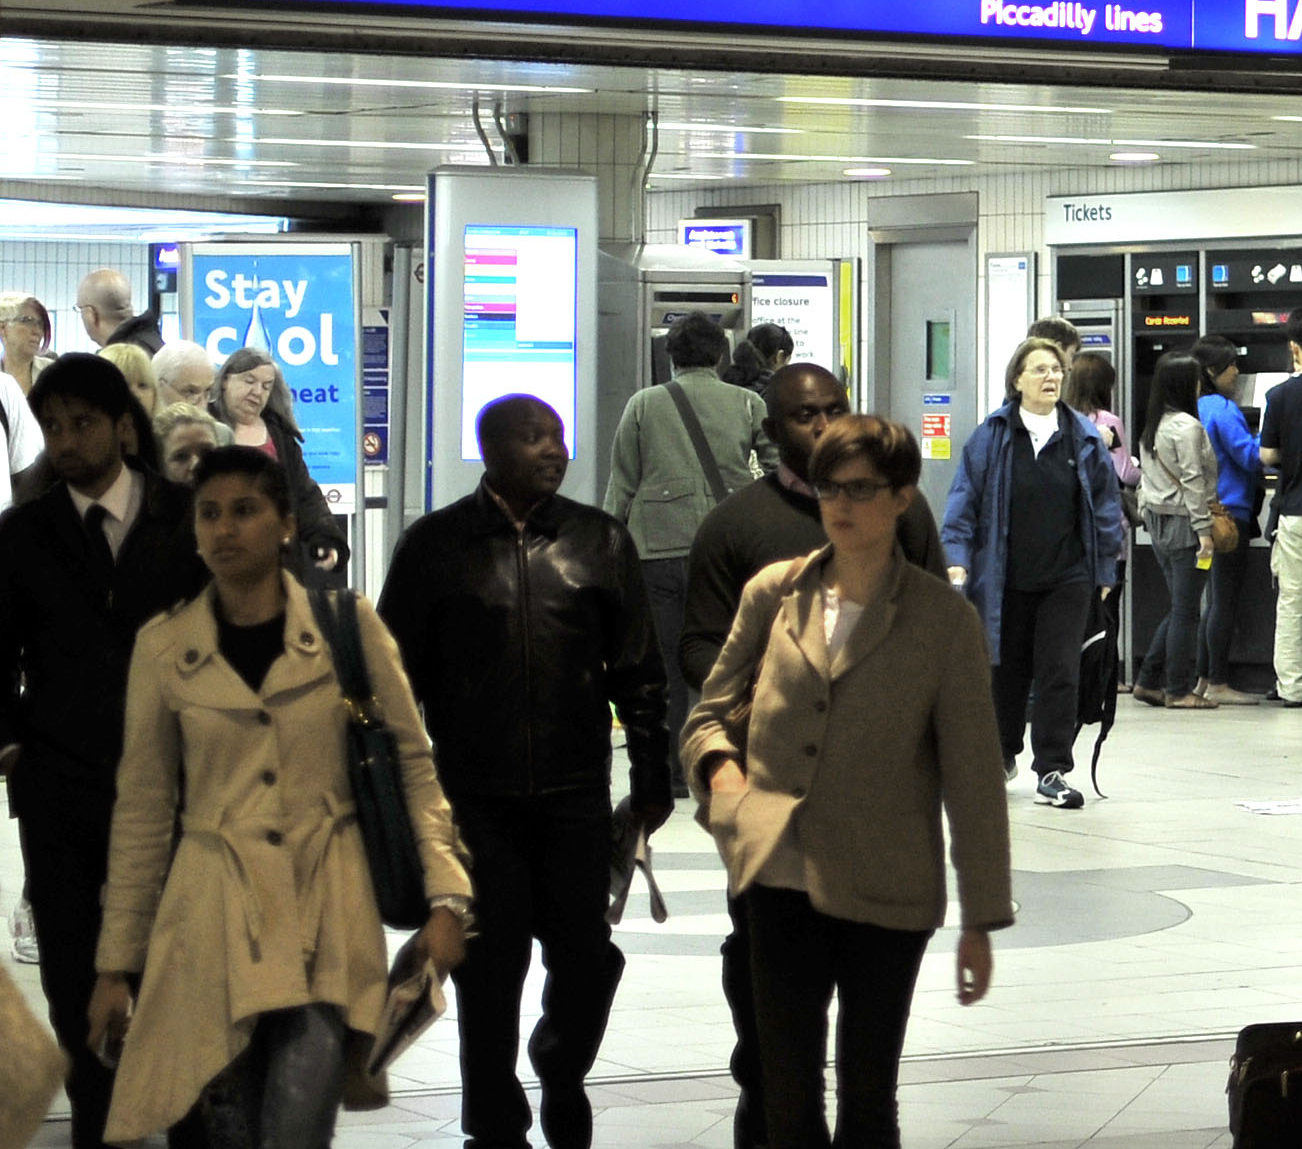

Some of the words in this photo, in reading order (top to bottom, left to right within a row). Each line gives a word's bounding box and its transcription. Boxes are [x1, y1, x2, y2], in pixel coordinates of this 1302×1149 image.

[1105, 3, 1163, 34] lines
[1063, 203, 1112, 222] Tickets
[204, 269, 309, 318] Stay
[774, 297, 810, 307] closure
[206, 313, 339, 366] col
